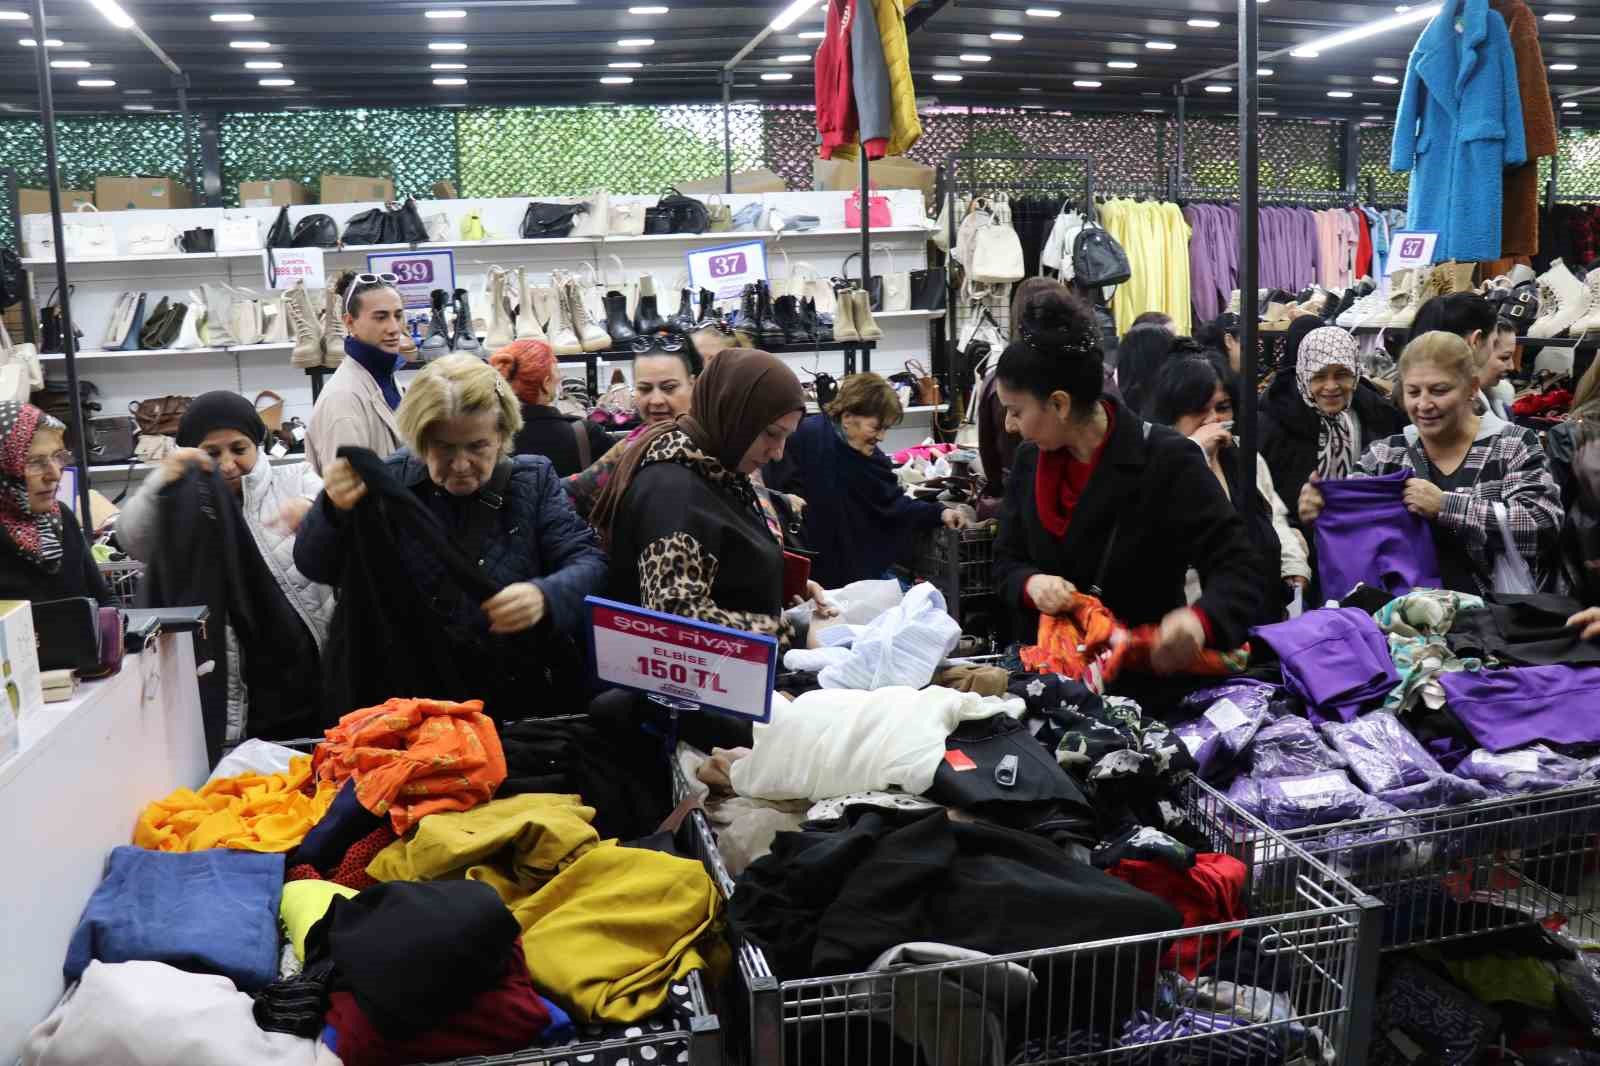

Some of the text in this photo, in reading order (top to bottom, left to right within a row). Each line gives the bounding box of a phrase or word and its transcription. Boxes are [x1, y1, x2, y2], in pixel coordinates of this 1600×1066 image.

[1403, 240, 1422, 256] 37
[397, 262, 428, 282] 39
[715, 254, 742, 275] 37
[678, 630, 749, 654] FİYAT
[653, 646, 708, 666] ELBİSE
[637, 656, 688, 684] 150
[693, 668, 729, 694] TL
